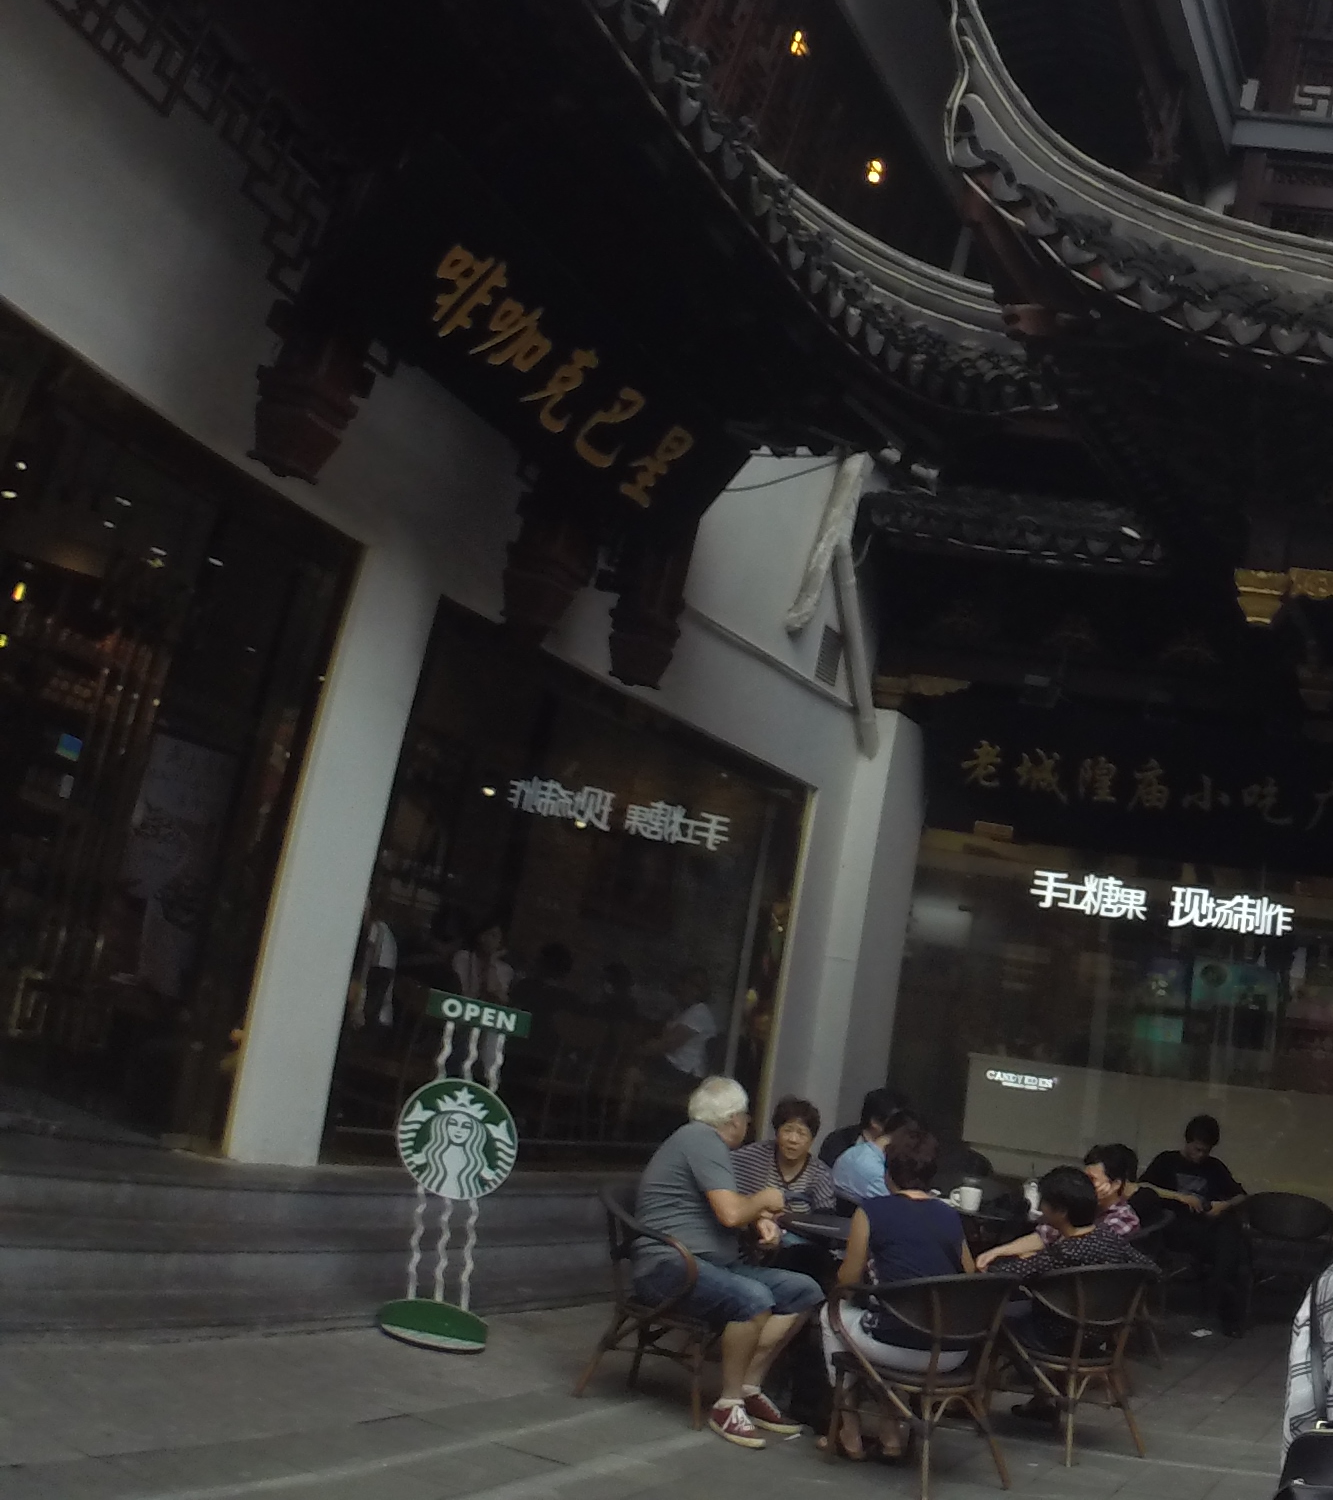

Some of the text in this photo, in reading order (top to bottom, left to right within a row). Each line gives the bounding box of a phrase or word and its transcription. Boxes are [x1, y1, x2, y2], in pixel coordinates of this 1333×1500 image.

[1030, 869, 1296, 937] 手工糖果 现场制作
[441, 998, 517, 1032] OPEN
